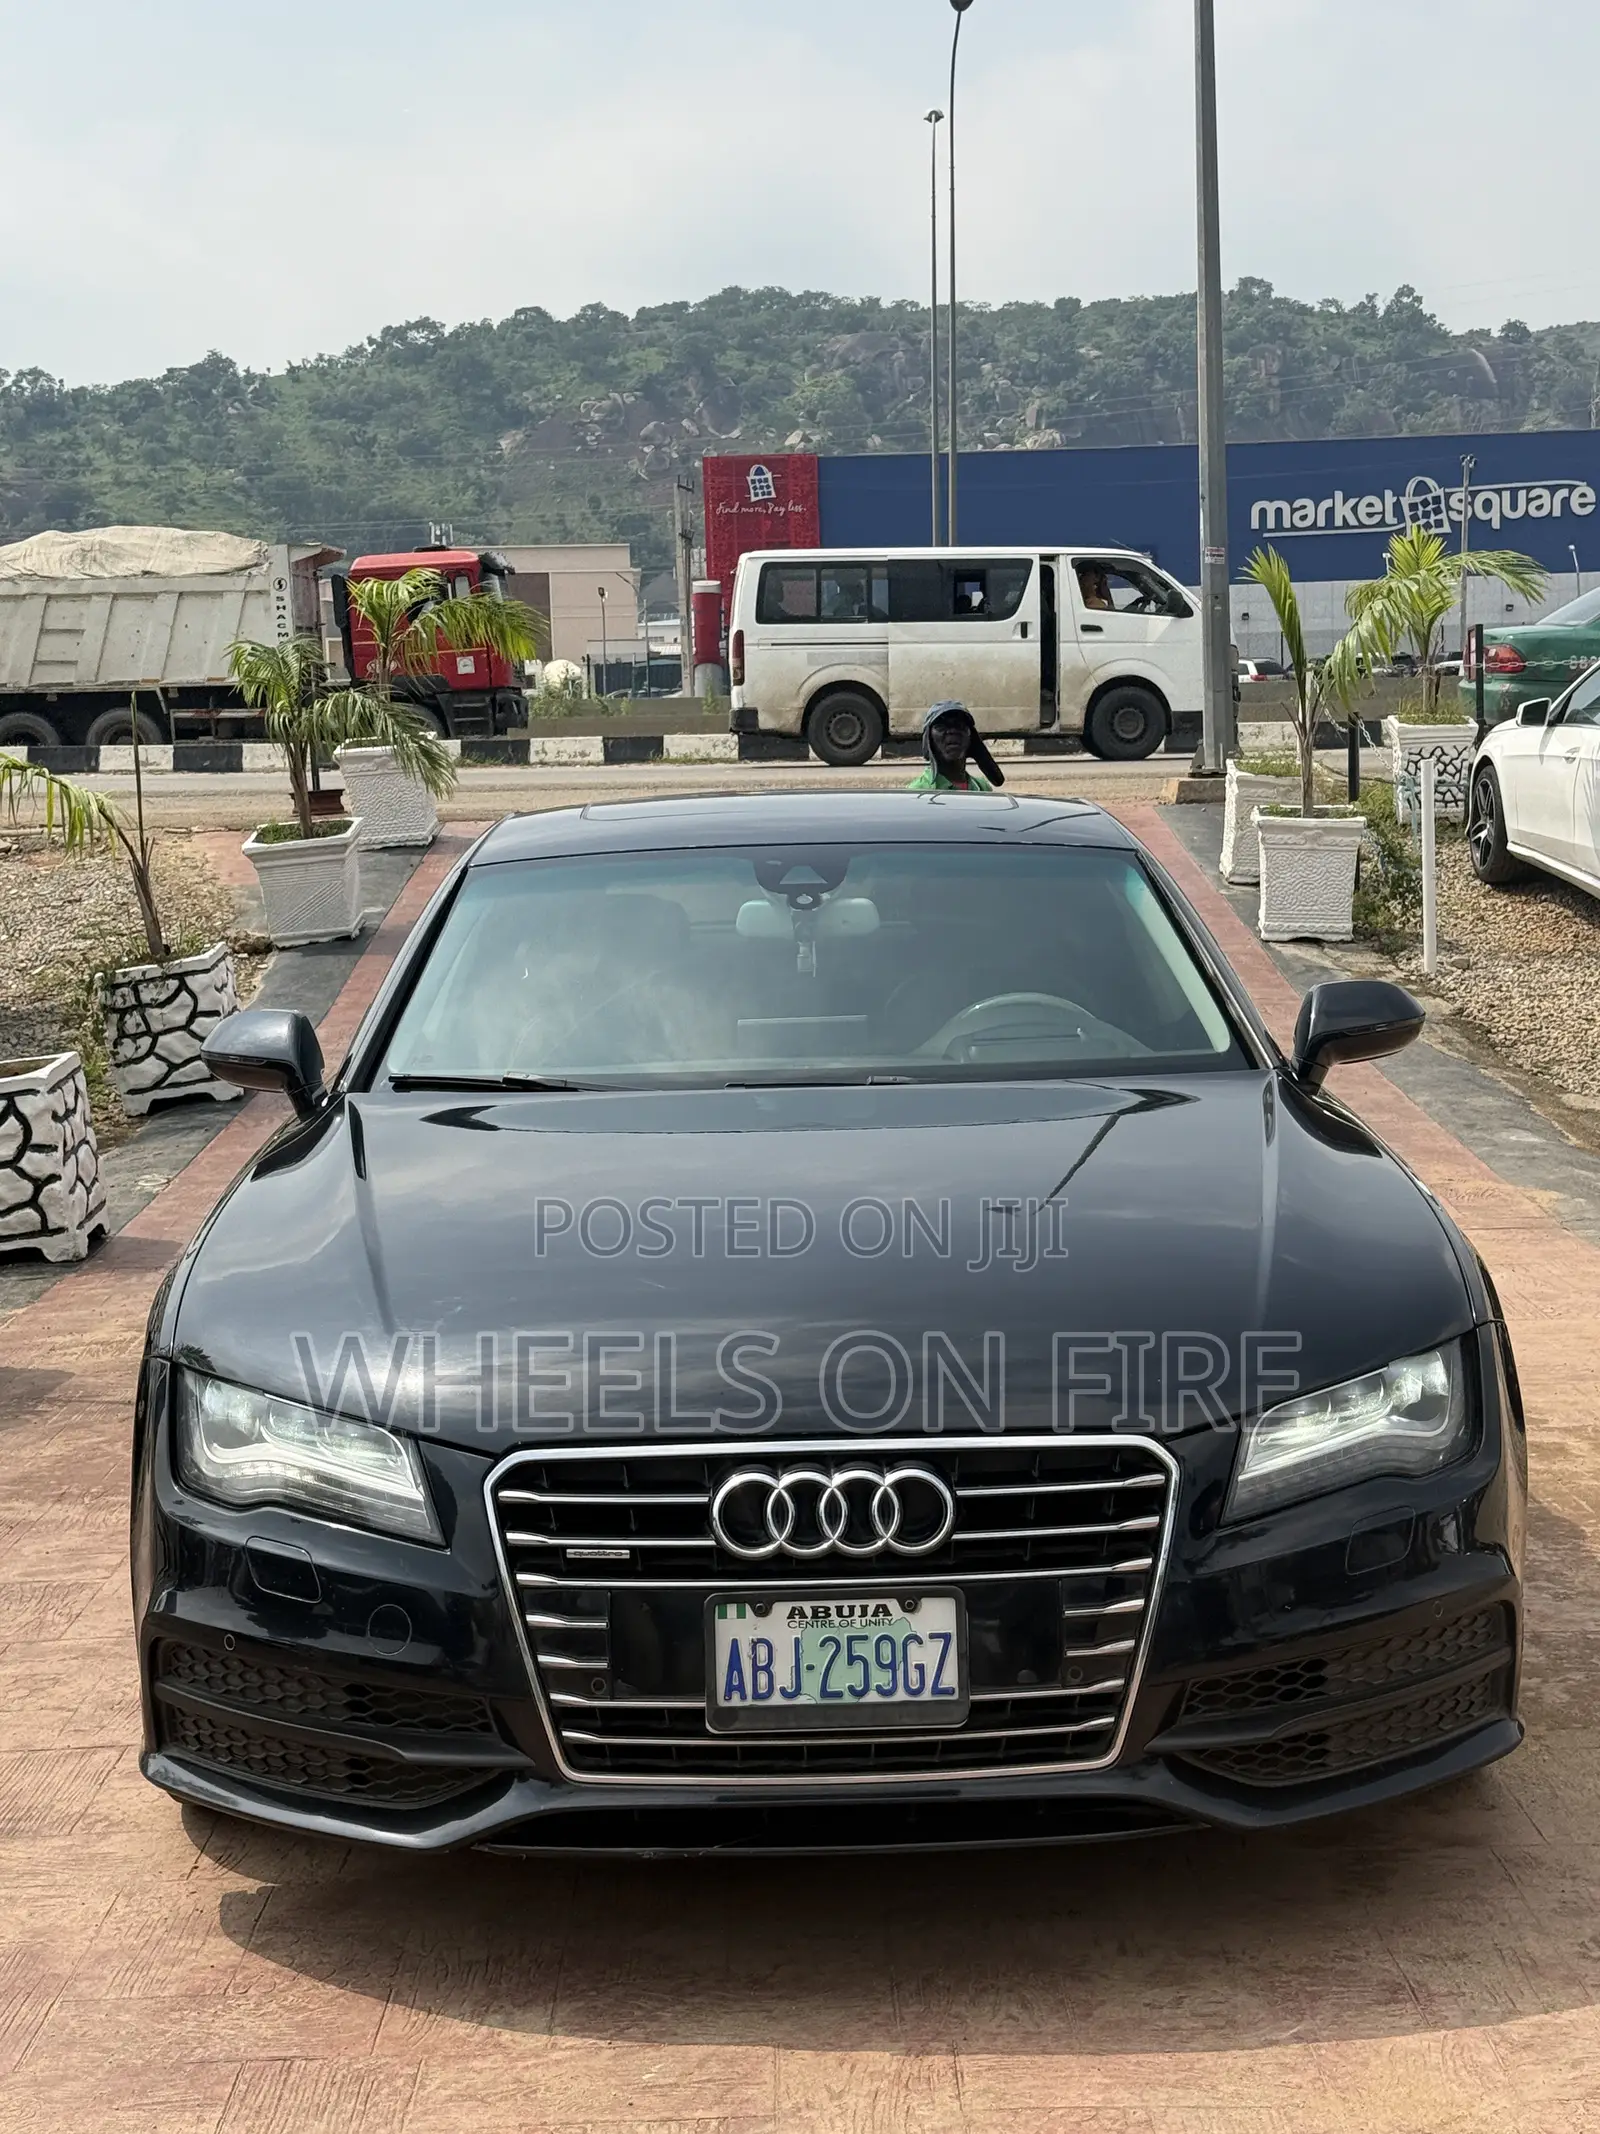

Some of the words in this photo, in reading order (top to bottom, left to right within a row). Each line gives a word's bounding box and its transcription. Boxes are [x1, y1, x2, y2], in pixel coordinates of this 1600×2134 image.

[716, 501, 740, 515] Find
[767, 502, 786, 517] Pay
[1250, 489, 1398, 530] market
[1448, 485, 1596, 530] square
[275, 595, 289, 645] SHACM
[787, 1604, 892, 1620] ABUJA
[787, 1618, 835, 1629] CENTRE
[838, 1618, 862, 1628] OF
[866, 1617, 893, 1627] UNITY
[724, 1632, 956, 1700] ABJ-259GZ
